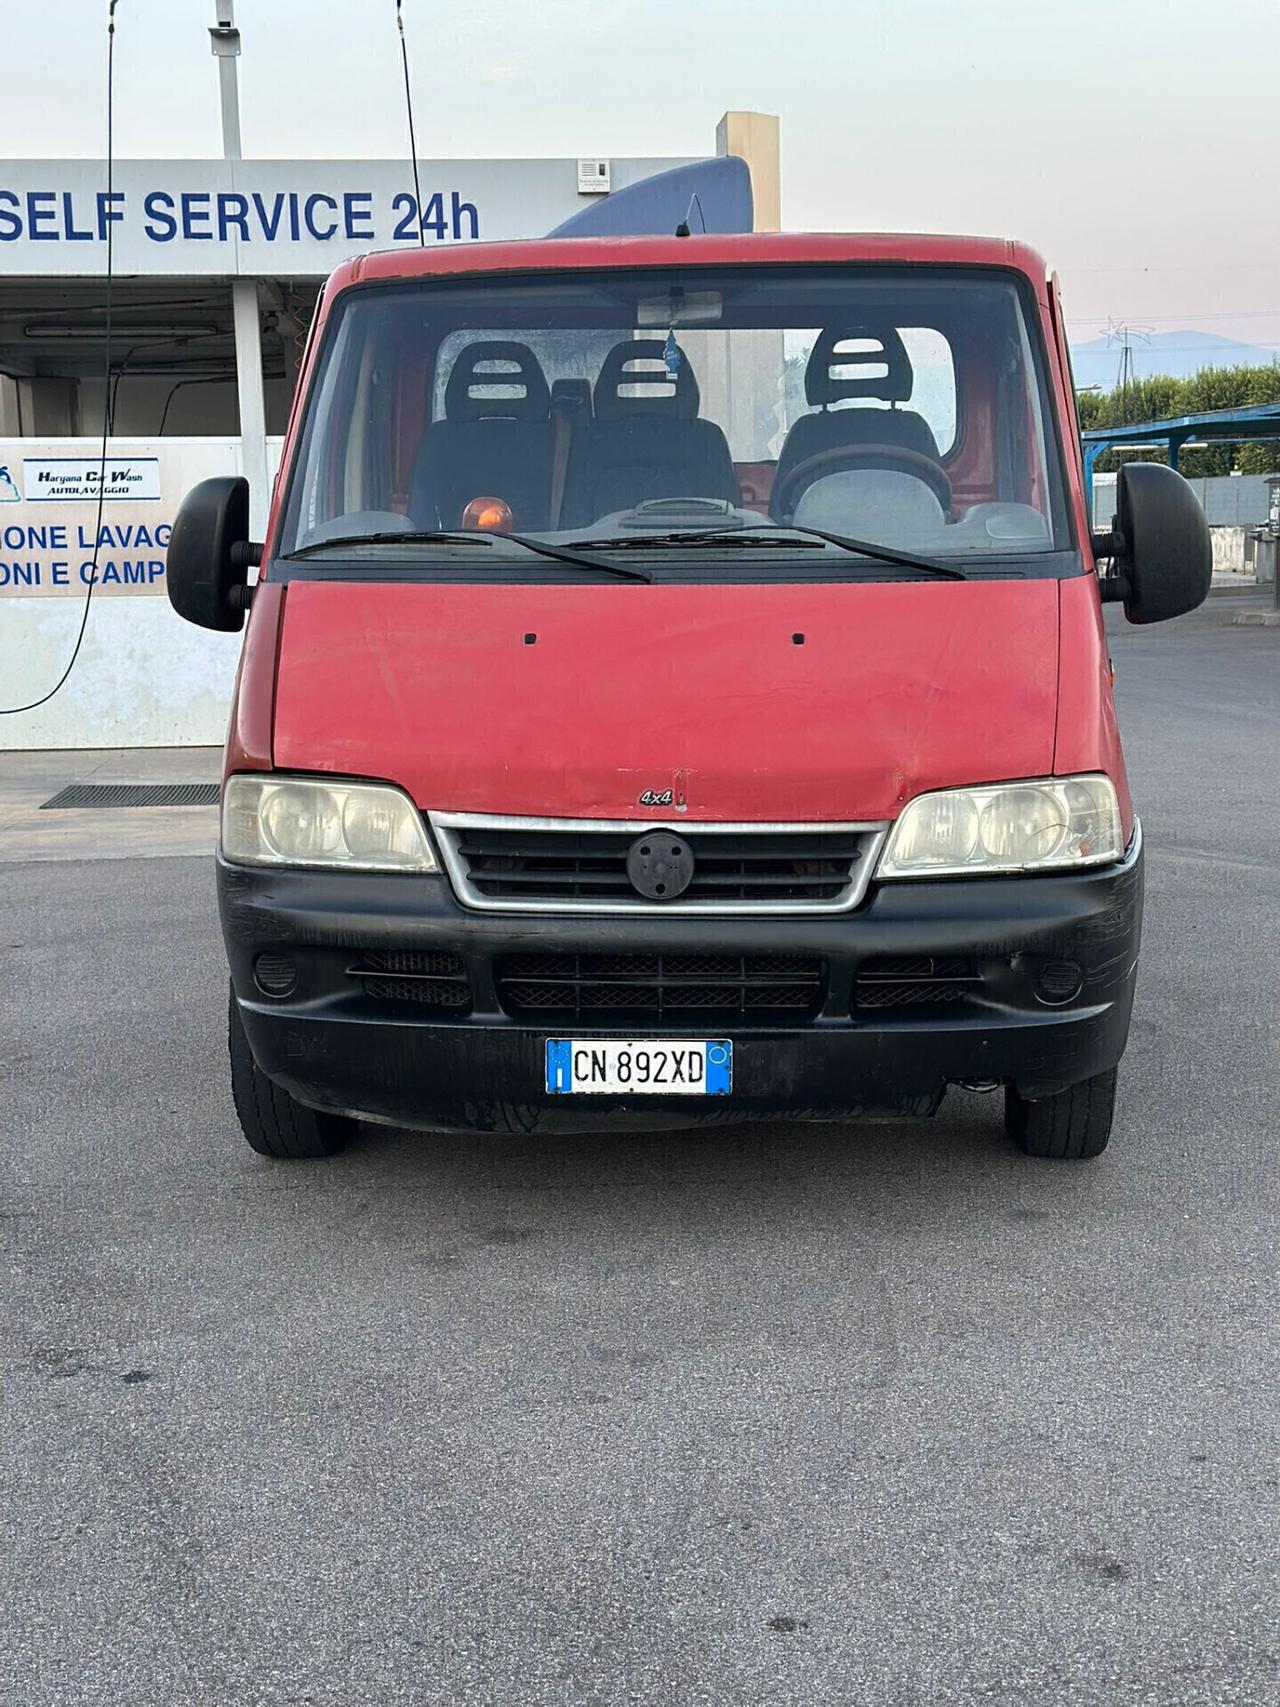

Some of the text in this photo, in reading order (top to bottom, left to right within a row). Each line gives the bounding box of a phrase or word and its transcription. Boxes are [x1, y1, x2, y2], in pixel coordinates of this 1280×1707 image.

[0, 190, 480, 241] SELF SERVICE 24h
[38, 471, 82, 484] Haryana
[111, 468, 143, 483] Wash
[47, 486, 130, 496] AUTOLAVAGGIO
[0, 526, 68, 550] ONE
[52, 562, 70, 585] E
[640, 790, 672, 805] 4x4
[574, 1050, 607, 1082] CN
[617, 1051, 703, 1083] 892XD
